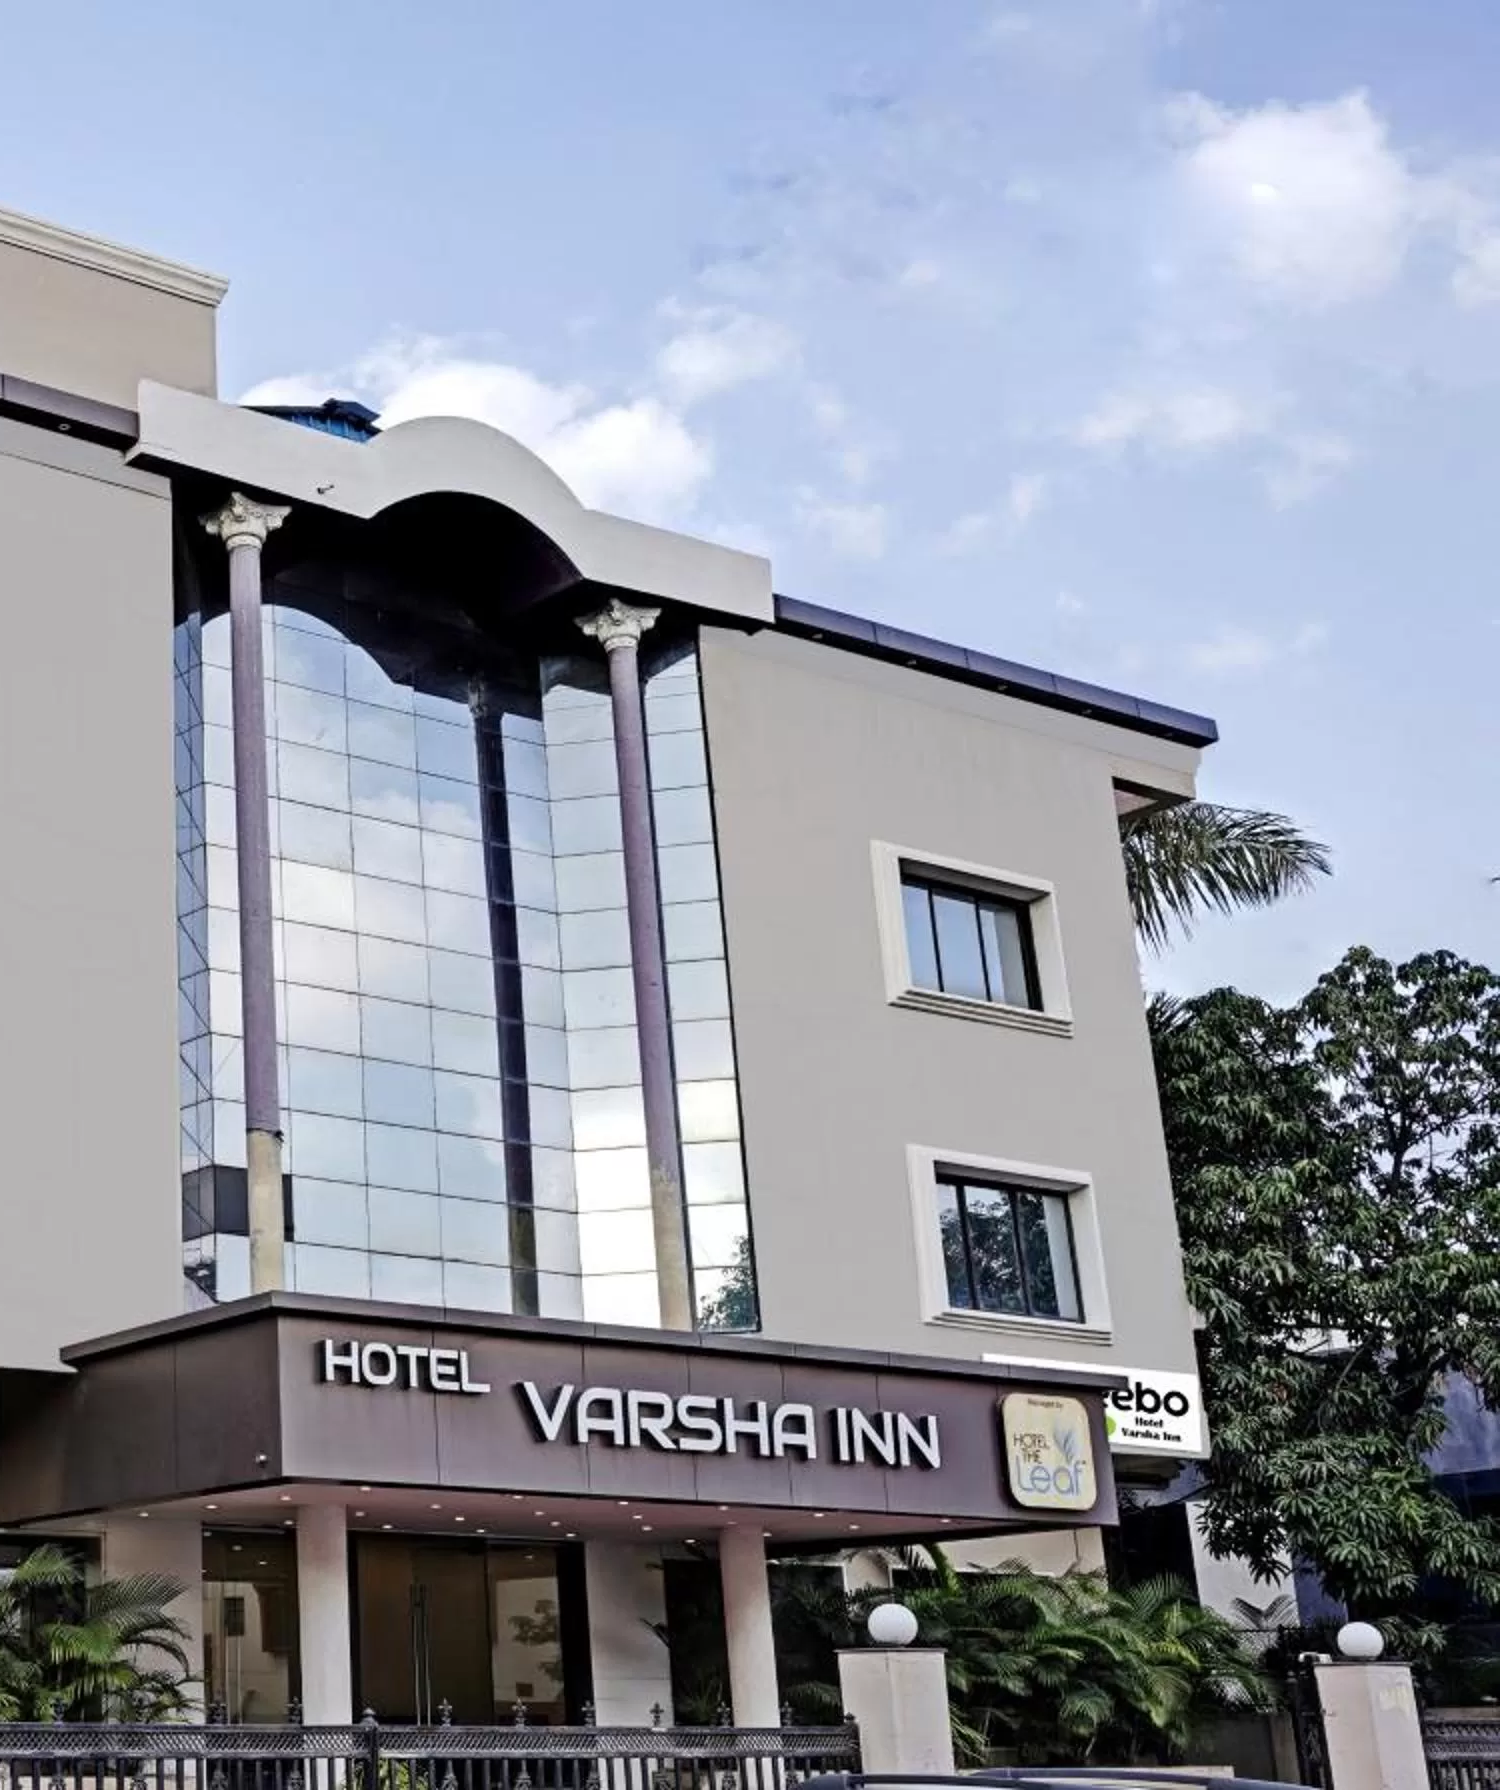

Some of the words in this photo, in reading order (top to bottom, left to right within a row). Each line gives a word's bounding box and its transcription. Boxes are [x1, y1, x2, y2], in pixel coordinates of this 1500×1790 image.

[322, 1338, 491, 1393] HOTEL
[520, 1380, 818, 1460] VARSHA
[834, 1406, 942, 1469] INN
[1135, 1416, 1164, 1429] Hotel
[1013, 1432, 1050, 1450] HOTEL
[1121, 1427, 1161, 1441] Varsha
[1163, 1431, 1182, 1442] Inn
[1021, 1447, 1043, 1465] THE
[1015, 1454, 1083, 1496] Leaf
